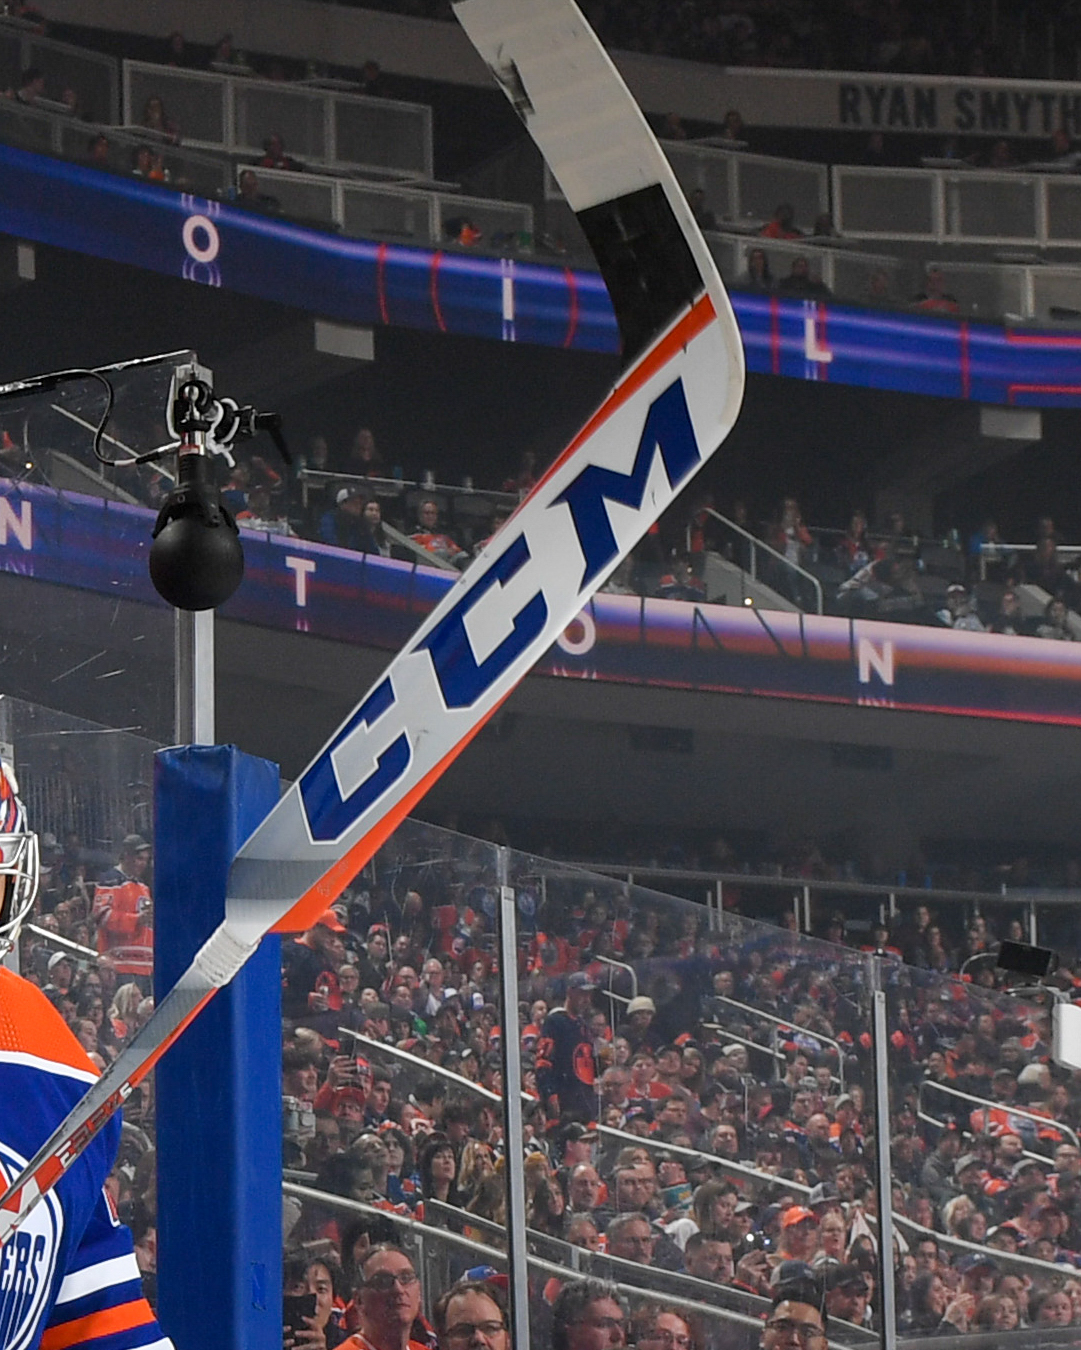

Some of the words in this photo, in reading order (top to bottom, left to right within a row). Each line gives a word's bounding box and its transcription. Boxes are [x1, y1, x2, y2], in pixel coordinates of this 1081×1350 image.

[839, 83, 937, 128] RYAN
[953, 88, 1081, 134] SMYTH
[297, 376, 701, 844] CCM
